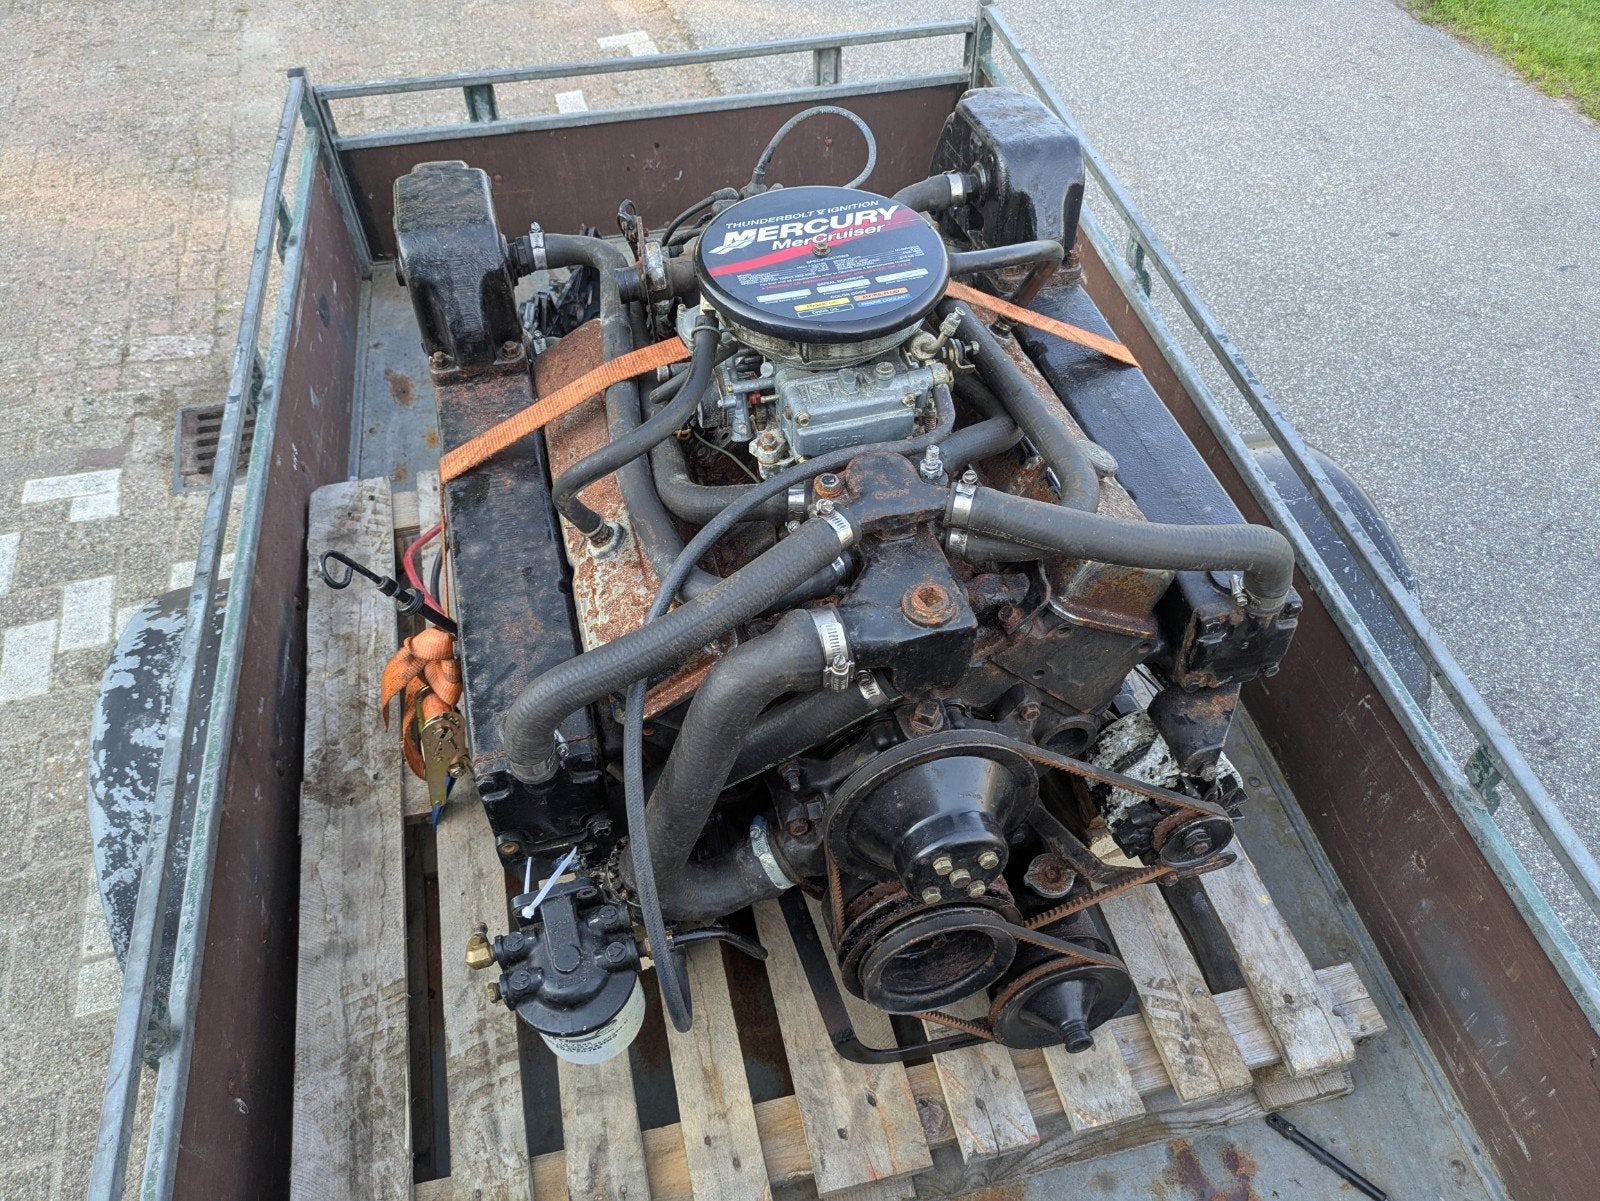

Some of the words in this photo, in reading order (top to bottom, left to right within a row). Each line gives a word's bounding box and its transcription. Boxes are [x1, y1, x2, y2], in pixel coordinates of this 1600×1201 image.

[721, 205, 899, 248] MERCURY
[725, 209, 814, 229] THUNDERBOLT
[828, 200, 879, 214] IGNITION
[772, 224, 886, 251] MerCruiser
[817, 434, 865, 450] HOLLEY
